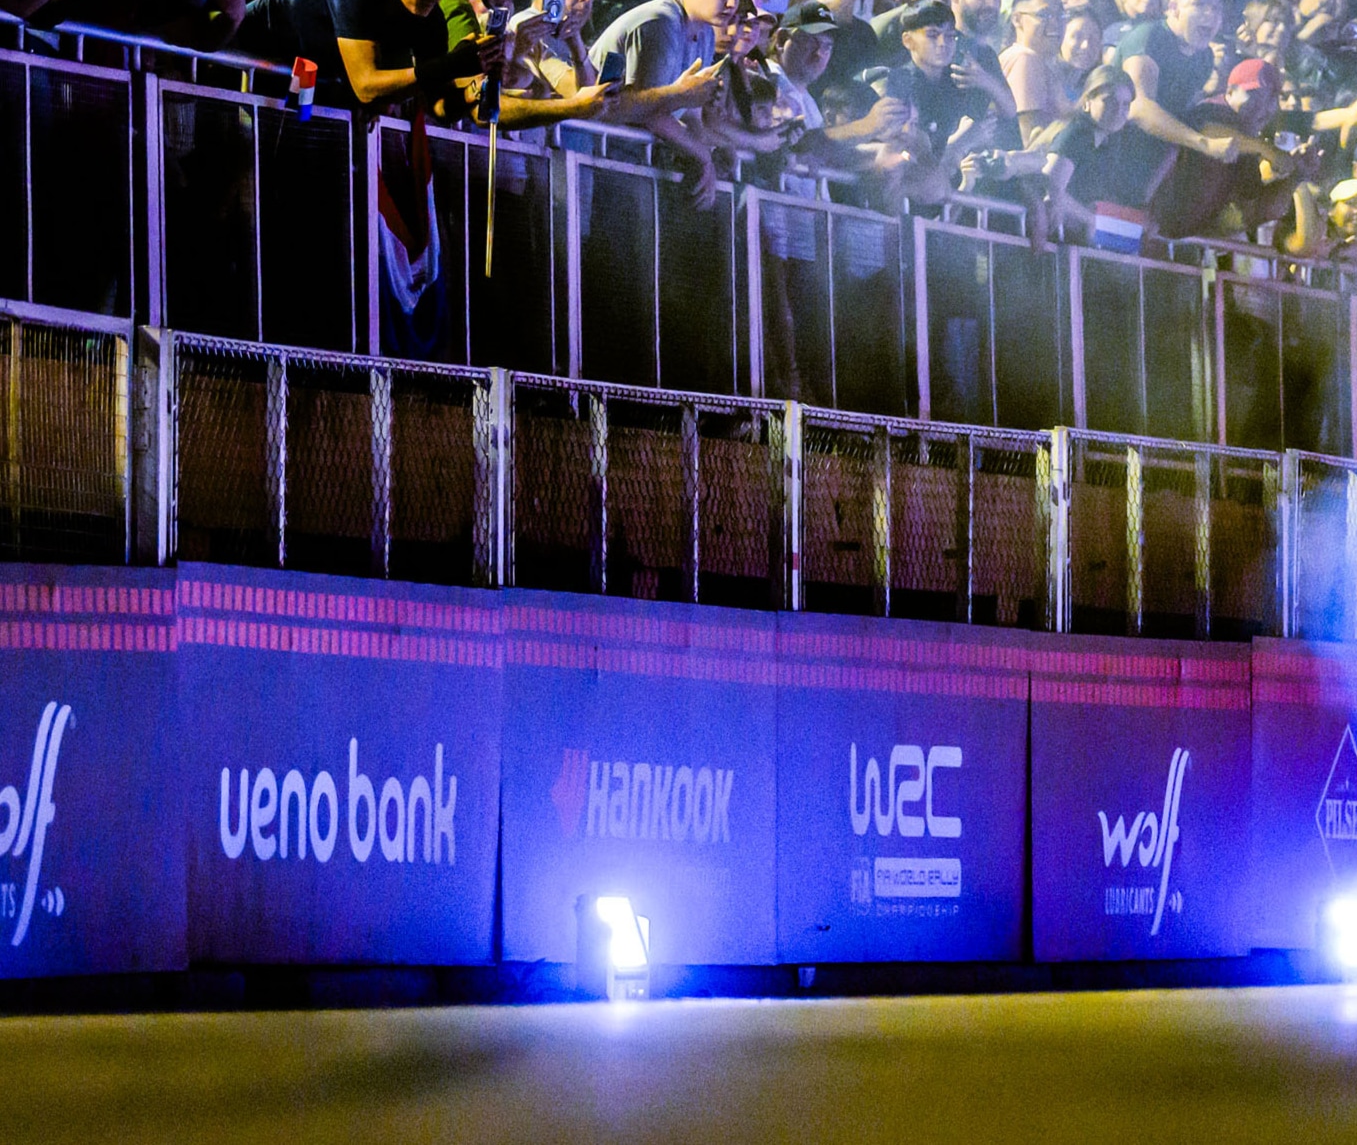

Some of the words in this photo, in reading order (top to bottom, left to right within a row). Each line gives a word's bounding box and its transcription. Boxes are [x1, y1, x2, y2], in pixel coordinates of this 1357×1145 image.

[0, 701, 72, 947] olf
[220, 766, 340, 864] ueno
[348, 736, 458, 867] bank
[850, 741, 963, 838] WRC
[1097, 746, 1191, 936] wolf
